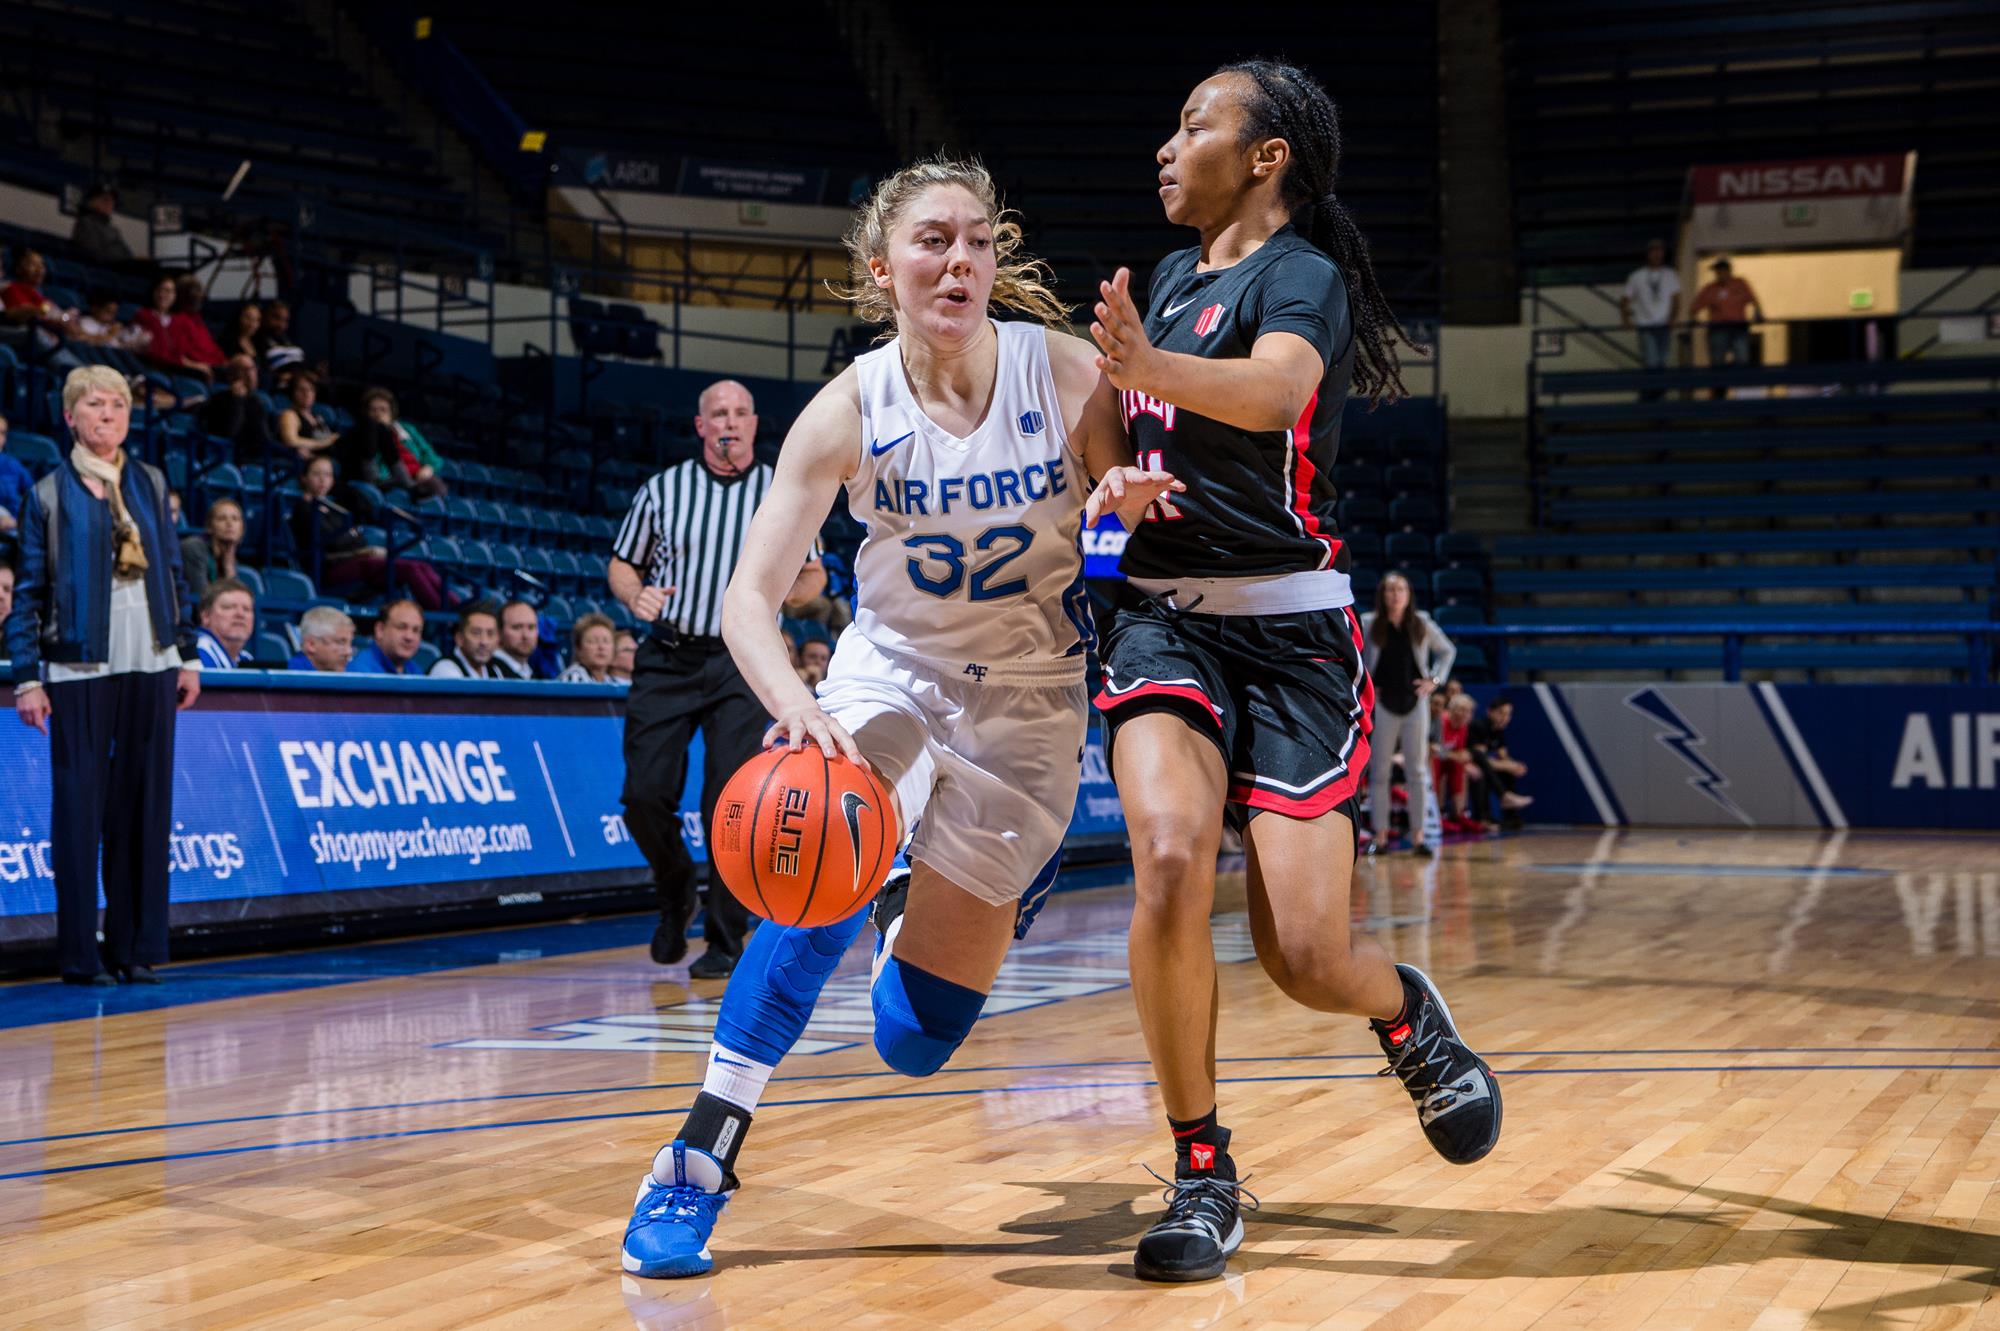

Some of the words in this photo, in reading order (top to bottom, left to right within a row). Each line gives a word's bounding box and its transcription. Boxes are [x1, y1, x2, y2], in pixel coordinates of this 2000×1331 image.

[1718, 162, 1886, 197] NISSAN
[874, 478, 930, 516] AIR
[938, 458, 1068, 516] FORCE
[902, 522, 1037, 603] 32
[963, 663, 988, 682] AF
[279, 741, 517, 808] EXCHANGE
[310, 816, 533, 873] shopmyexchange.com
[769, 785, 786, 874] CHAMPIONSHIP
[775, 787, 810, 877] ELITE
